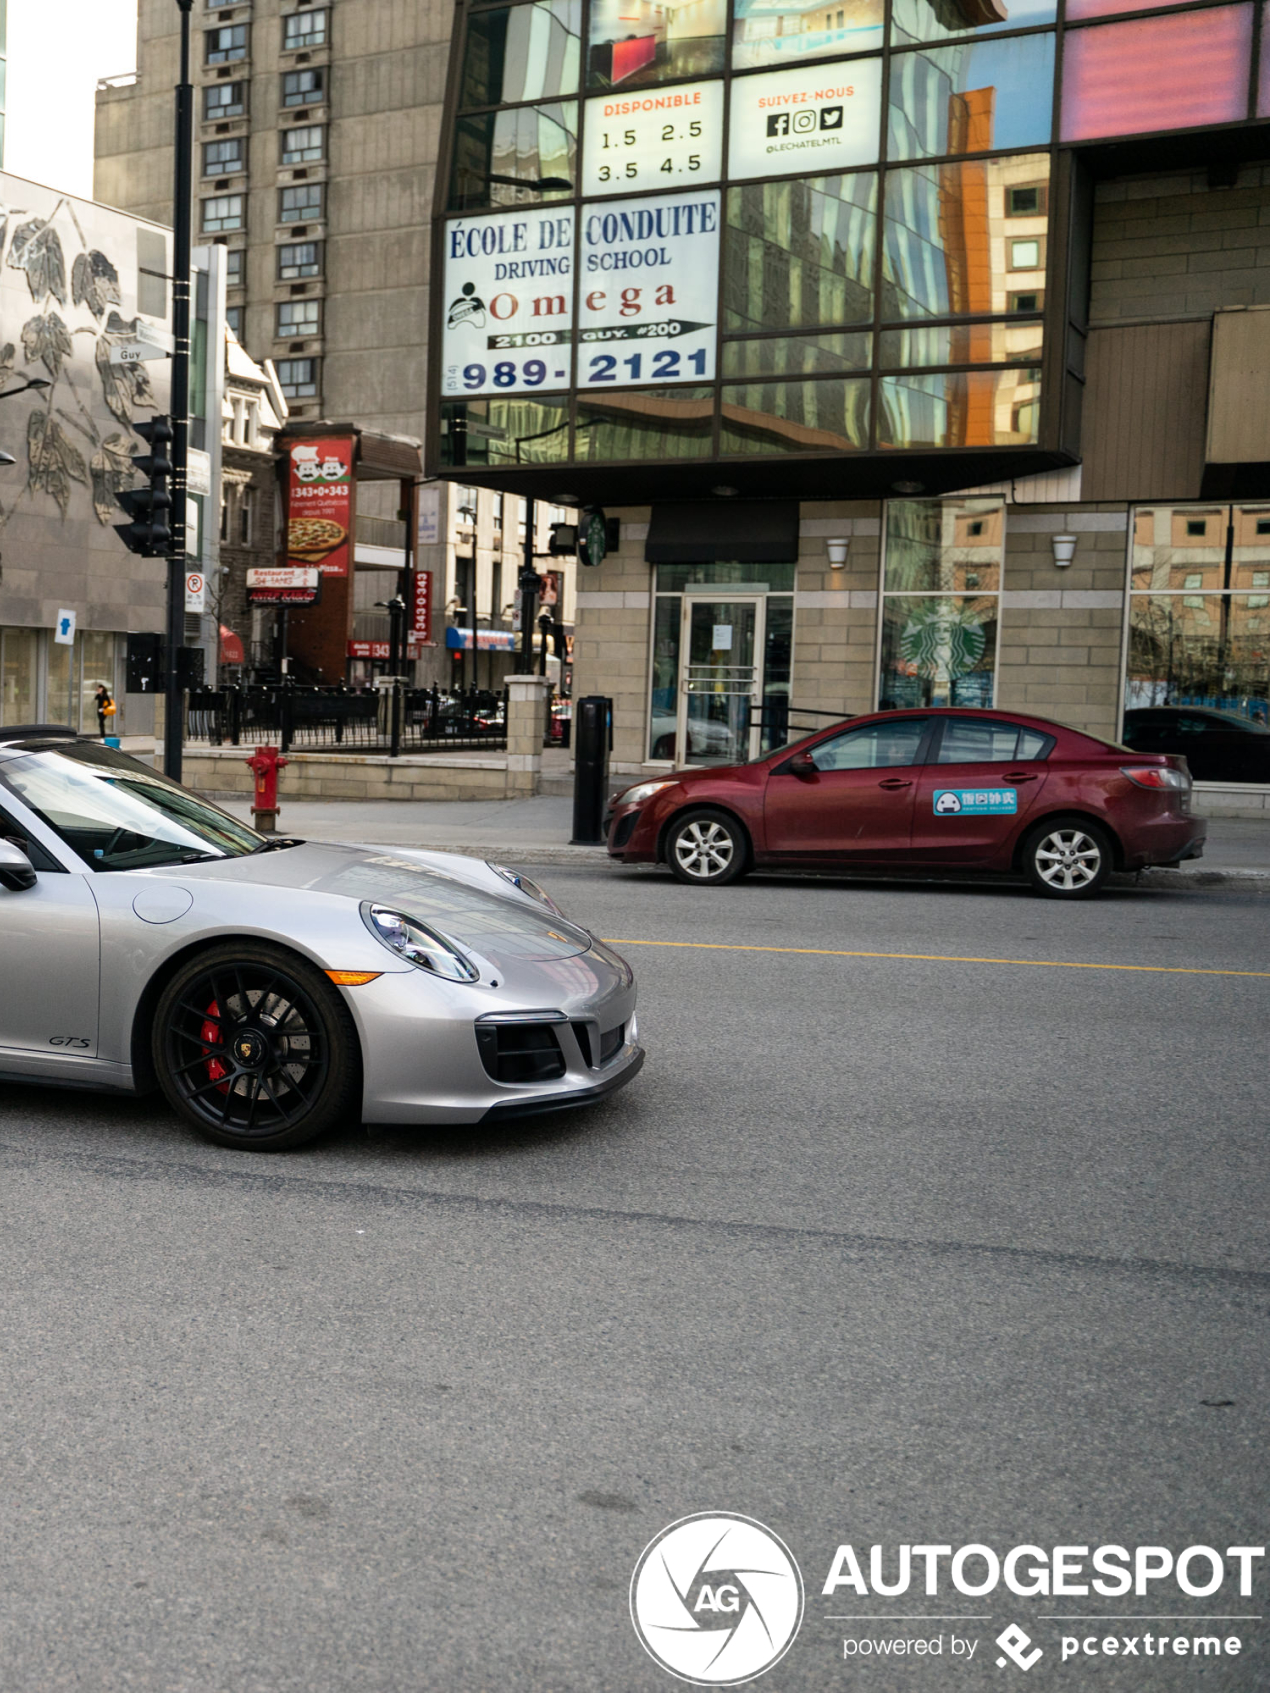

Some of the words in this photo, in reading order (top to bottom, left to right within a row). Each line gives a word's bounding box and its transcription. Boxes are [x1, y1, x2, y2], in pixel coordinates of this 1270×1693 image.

[604, 92, 702, 117] DISPONIBLE
[758, 86, 855, 108] SUIVEZ-NOUS
[766, 137, 842, 154] @LECHATELMTL
[450, 222, 528, 259] ÉCOLE
[538, 218, 571, 250] DE
[586, 202, 717, 246] CONDUITE
[494, 256, 571, 281] DRIVING
[587, 247, 672, 272] SCHOOL
[489, 283, 677, 320] Omega
[495, 332, 557, 348] 2100
[582, 329, 629, 341] GUY.
[636, 322, 682, 336] #200
[120, 350, 141, 361] Guy
[587, 348, 707, 382] 2121
[447, 364, 459, 391] (514)
[253, 569, 296, 577] Restaurant
[49, 1036, 91, 1048] GTS
